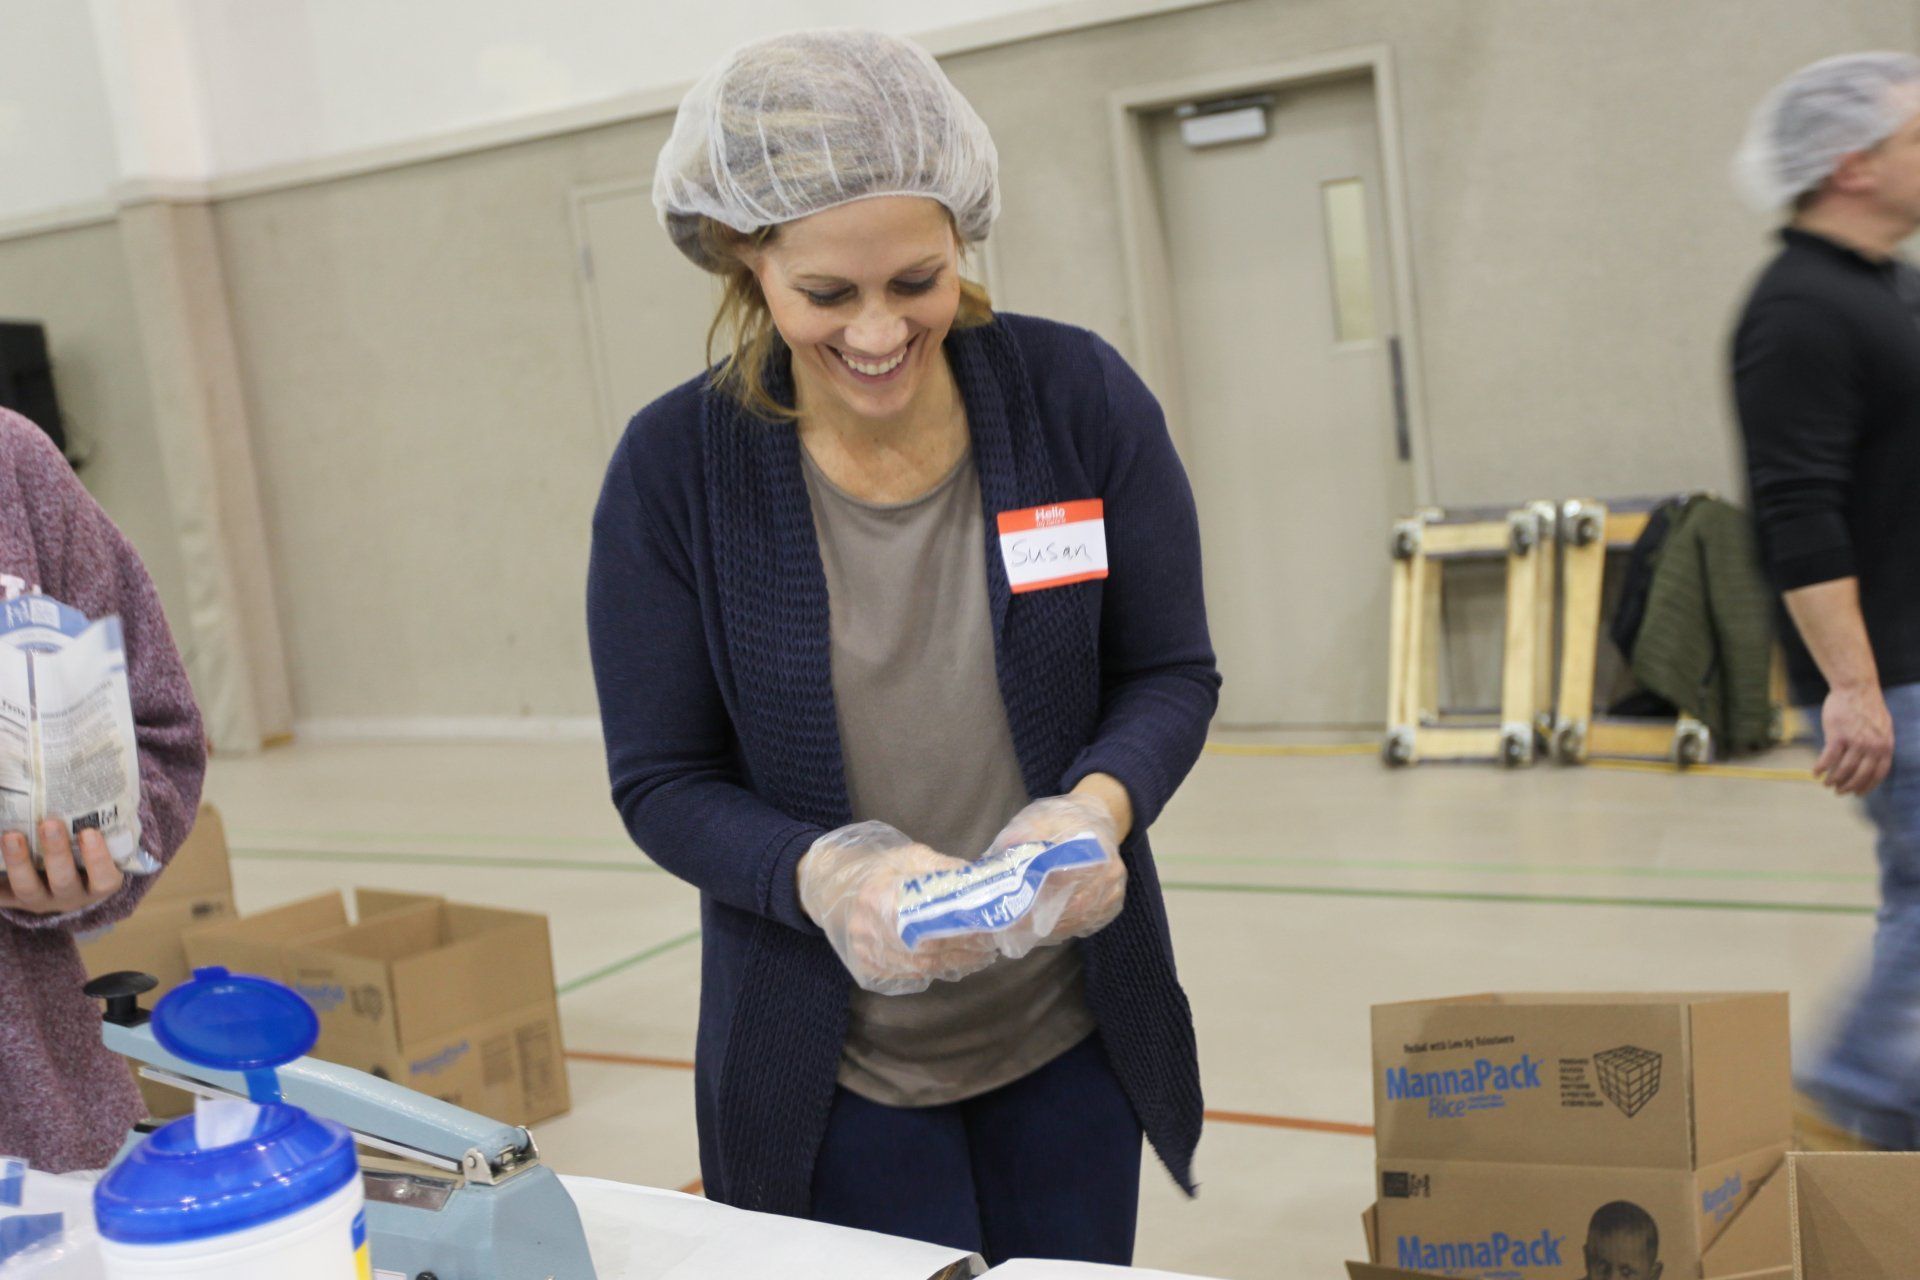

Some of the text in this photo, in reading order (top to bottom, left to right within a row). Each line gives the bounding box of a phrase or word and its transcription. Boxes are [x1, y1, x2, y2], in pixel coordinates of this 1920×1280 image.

[1035, 506, 1066, 521] Hello
[1010, 538, 1093, 568] Susan
[1385, 1053, 1542, 1099] MannaPack
[1428, 1097, 1466, 1119] Rice
[1397, 1228, 1562, 1270] MannaPack
